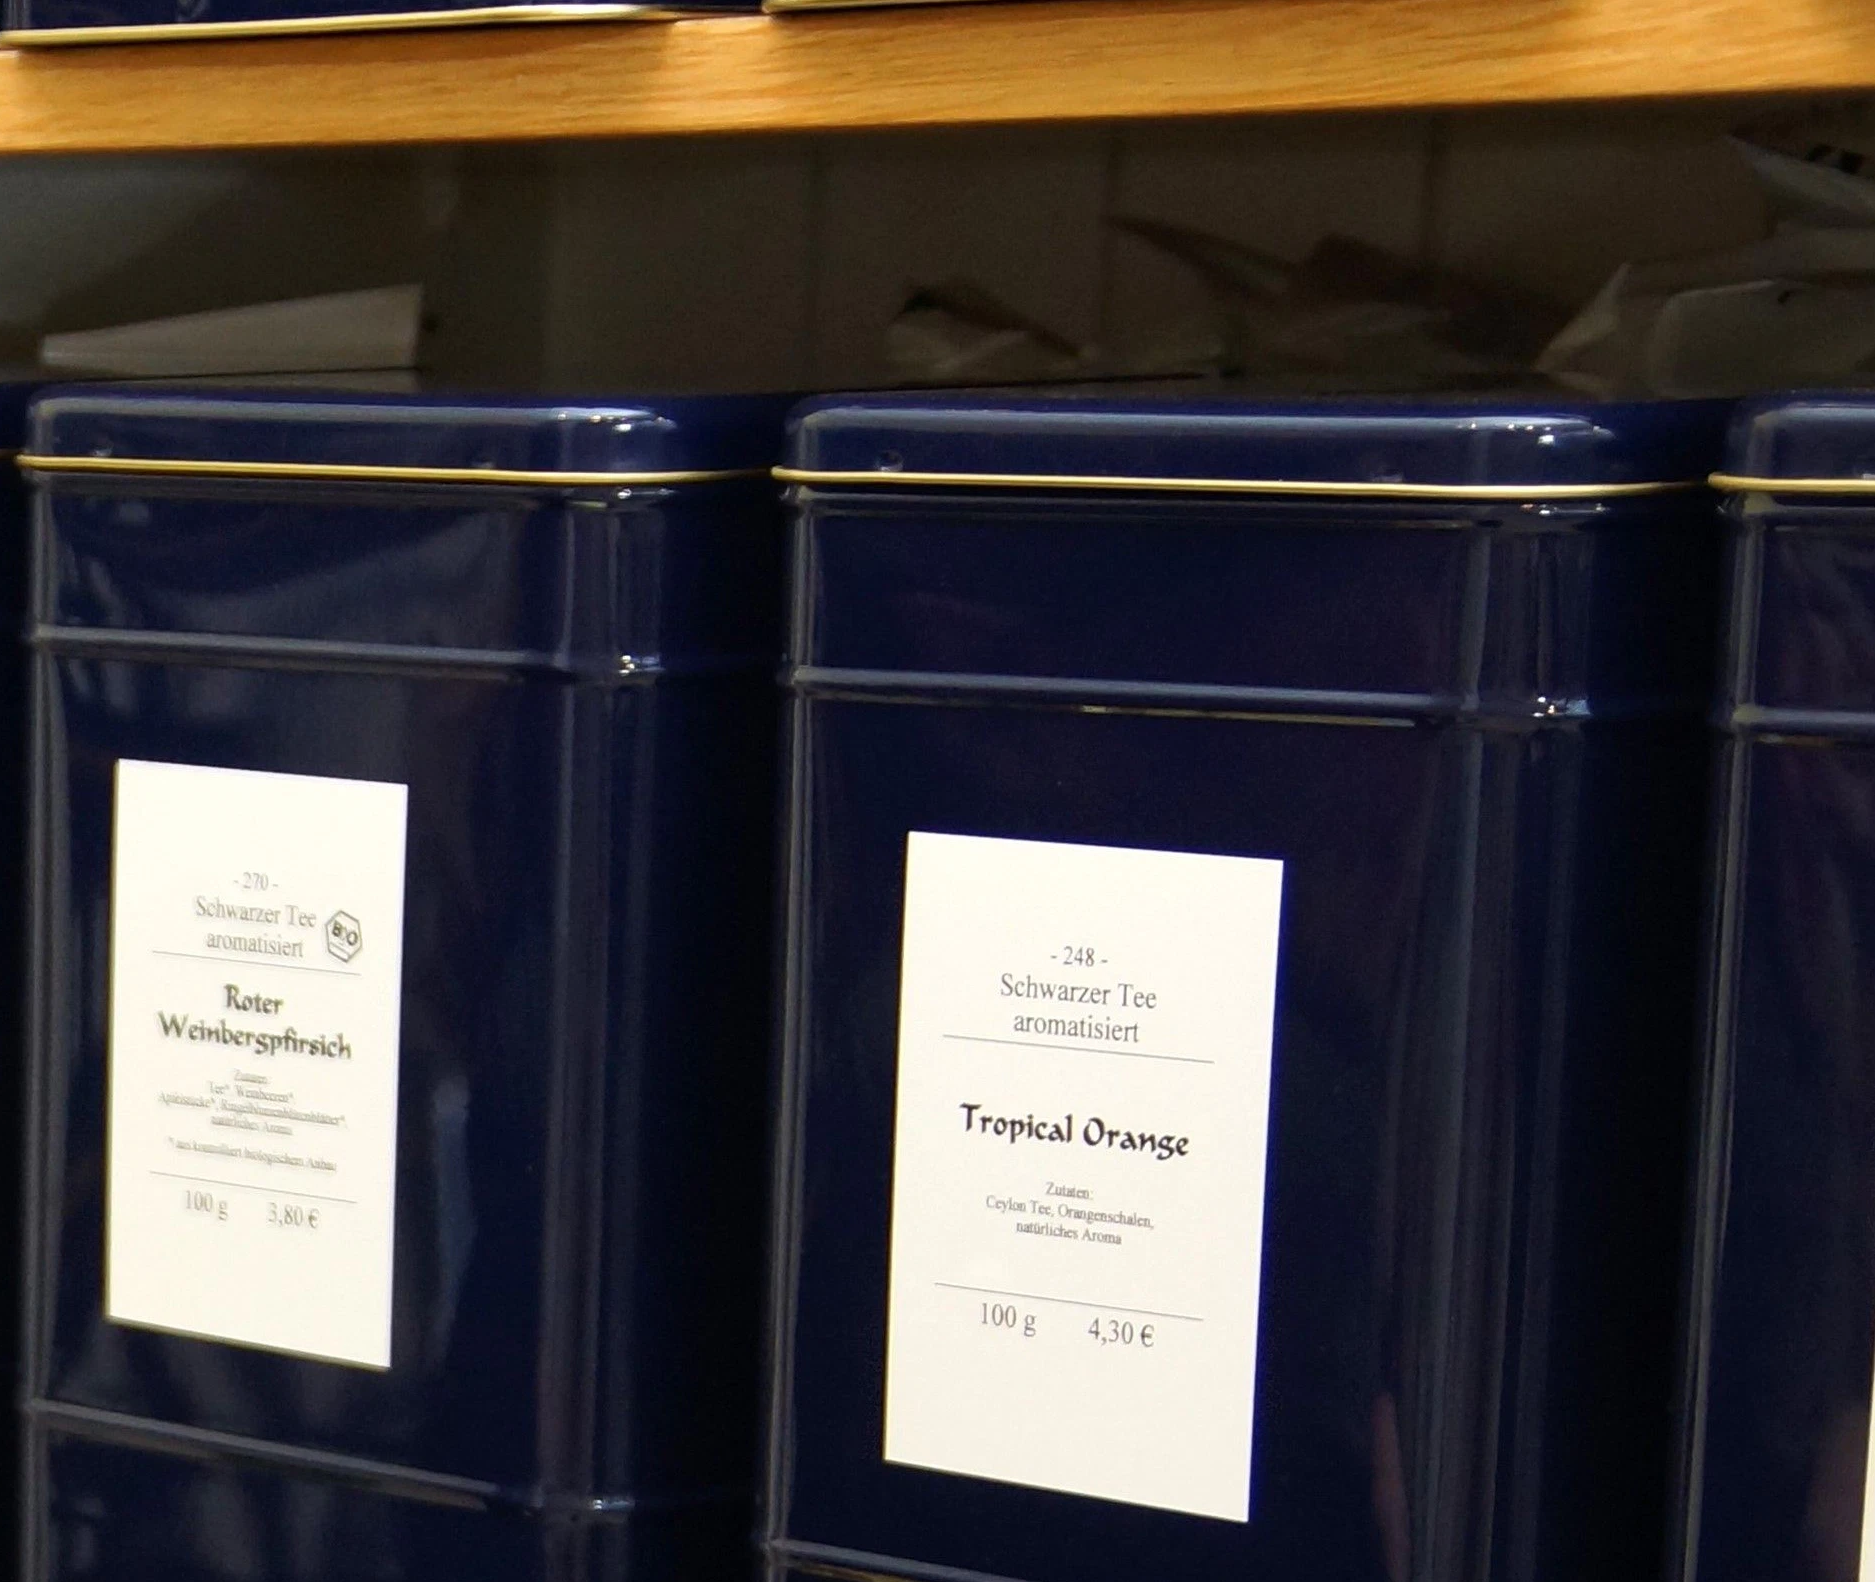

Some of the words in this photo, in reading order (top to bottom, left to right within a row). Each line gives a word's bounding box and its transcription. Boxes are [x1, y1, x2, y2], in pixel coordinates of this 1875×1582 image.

[242, 872, 269, 891] 270
[195, 895, 281, 925] Schwarzer
[285, 904, 317, 929] Tee
[206, 931, 304, 958] aromatisiert
[1063, 945, 1095, 967] 248
[224, 983, 284, 1015] Roter
[1000, 972, 1111, 1006] Schwarzer
[1117, 983, 1158, 1010] Tee
[158, 1010, 352, 1060] Weinbergpfirsich
[1013, 1014, 1140, 1044] aromatisiert
[959, 1102, 1074, 1145] Tropical
[1082, 1116, 1190, 1161] Orange
[1044, 1181, 1094, 1201] Zutaten:
[185, 1190, 213, 1212] 100
[218, 1200, 229, 1221] g
[268, 1202, 304, 1227] 3,80
[307, 1208, 320, 1230] €
[986, 1195, 1027, 1214] Ceylon
[1029, 1199, 1055, 1218] Tee,
[1057, 1203, 1155, 1230] Orangenschalen,
[1016, 1221, 1079, 1241] natürliches
[1082, 1228, 1123, 1246] Aroma
[980, 1302, 1017, 1329] 100
[1023, 1314, 1037, 1338] g
[1087, 1317, 1134, 1347] 4,30
[1140, 1323, 1155, 1348] €
